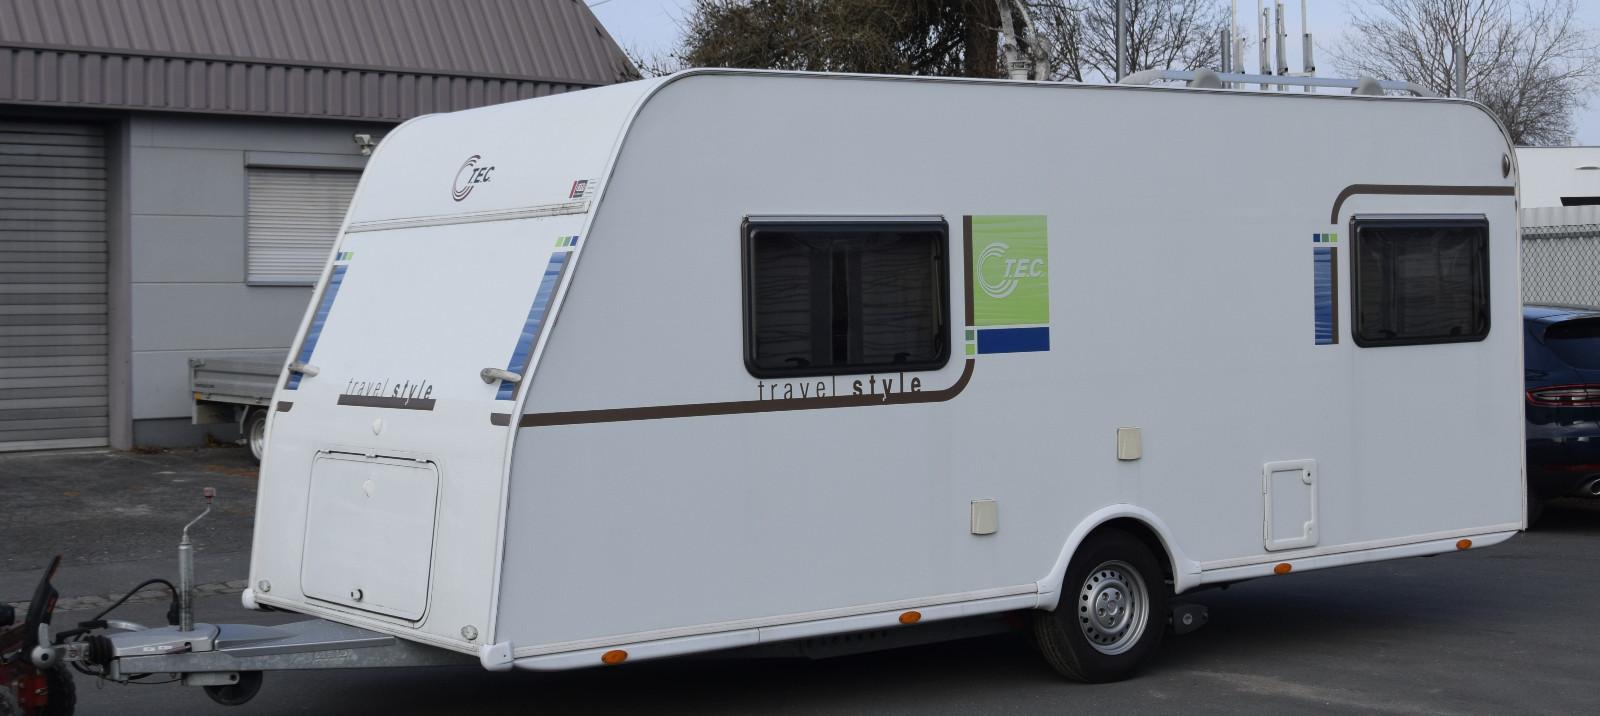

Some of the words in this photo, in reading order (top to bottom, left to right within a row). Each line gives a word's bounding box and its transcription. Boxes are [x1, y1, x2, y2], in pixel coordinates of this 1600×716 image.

[345, 377, 389, 398] travel
[392, 379, 433, 406] style
[758, 375, 836, 400] travel
[852, 371, 921, 403] style
